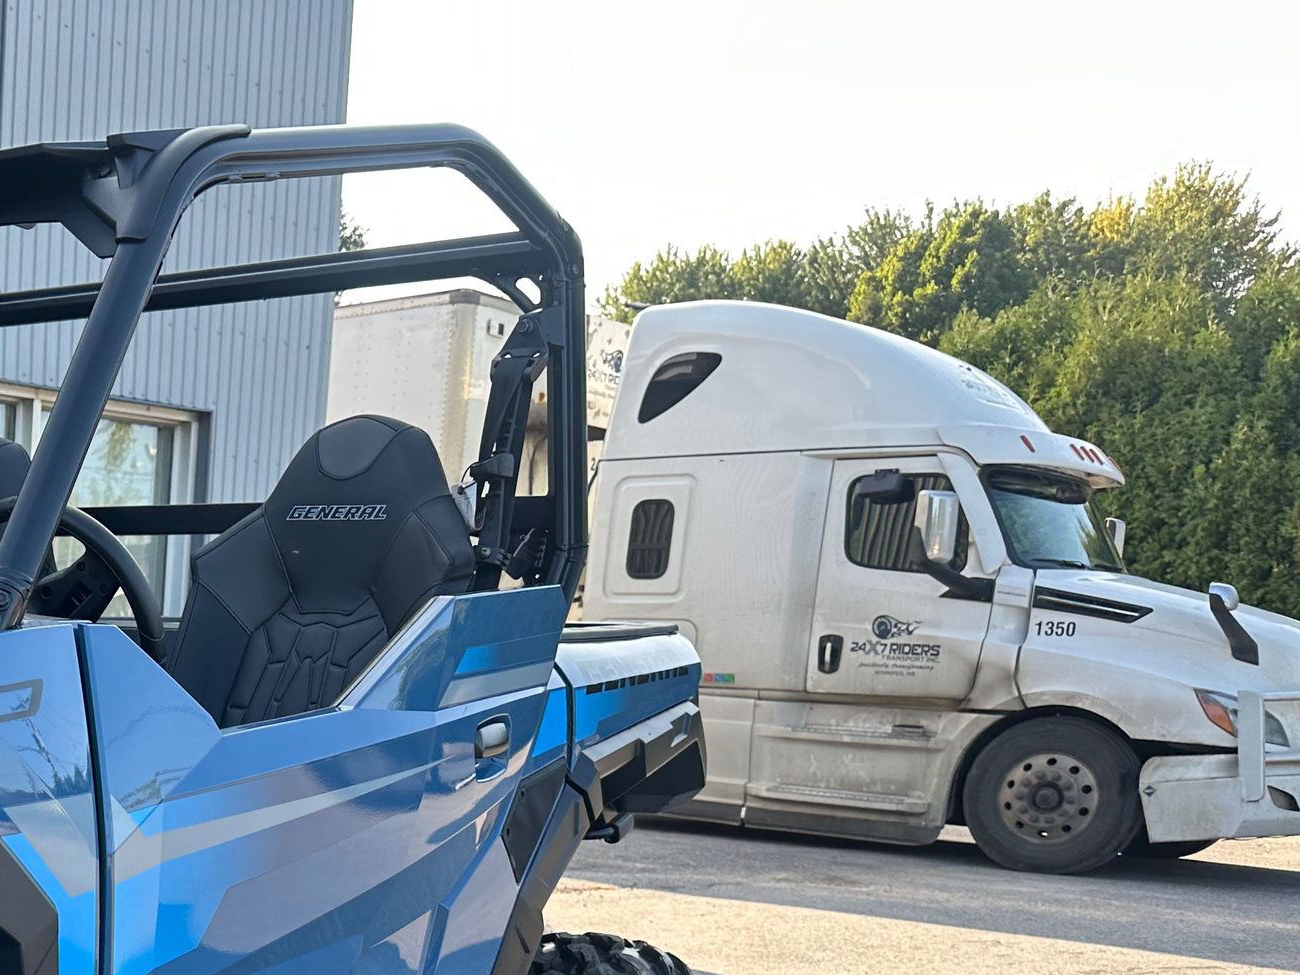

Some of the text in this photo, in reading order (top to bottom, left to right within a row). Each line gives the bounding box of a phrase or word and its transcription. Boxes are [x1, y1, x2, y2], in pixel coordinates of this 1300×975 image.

[286, 504, 386, 520] GENERAL
[1035, 621, 1076, 637] 1350
[889, 643, 941, 657] RIDERS
[882, 654, 925, 663] TRANSPORT
